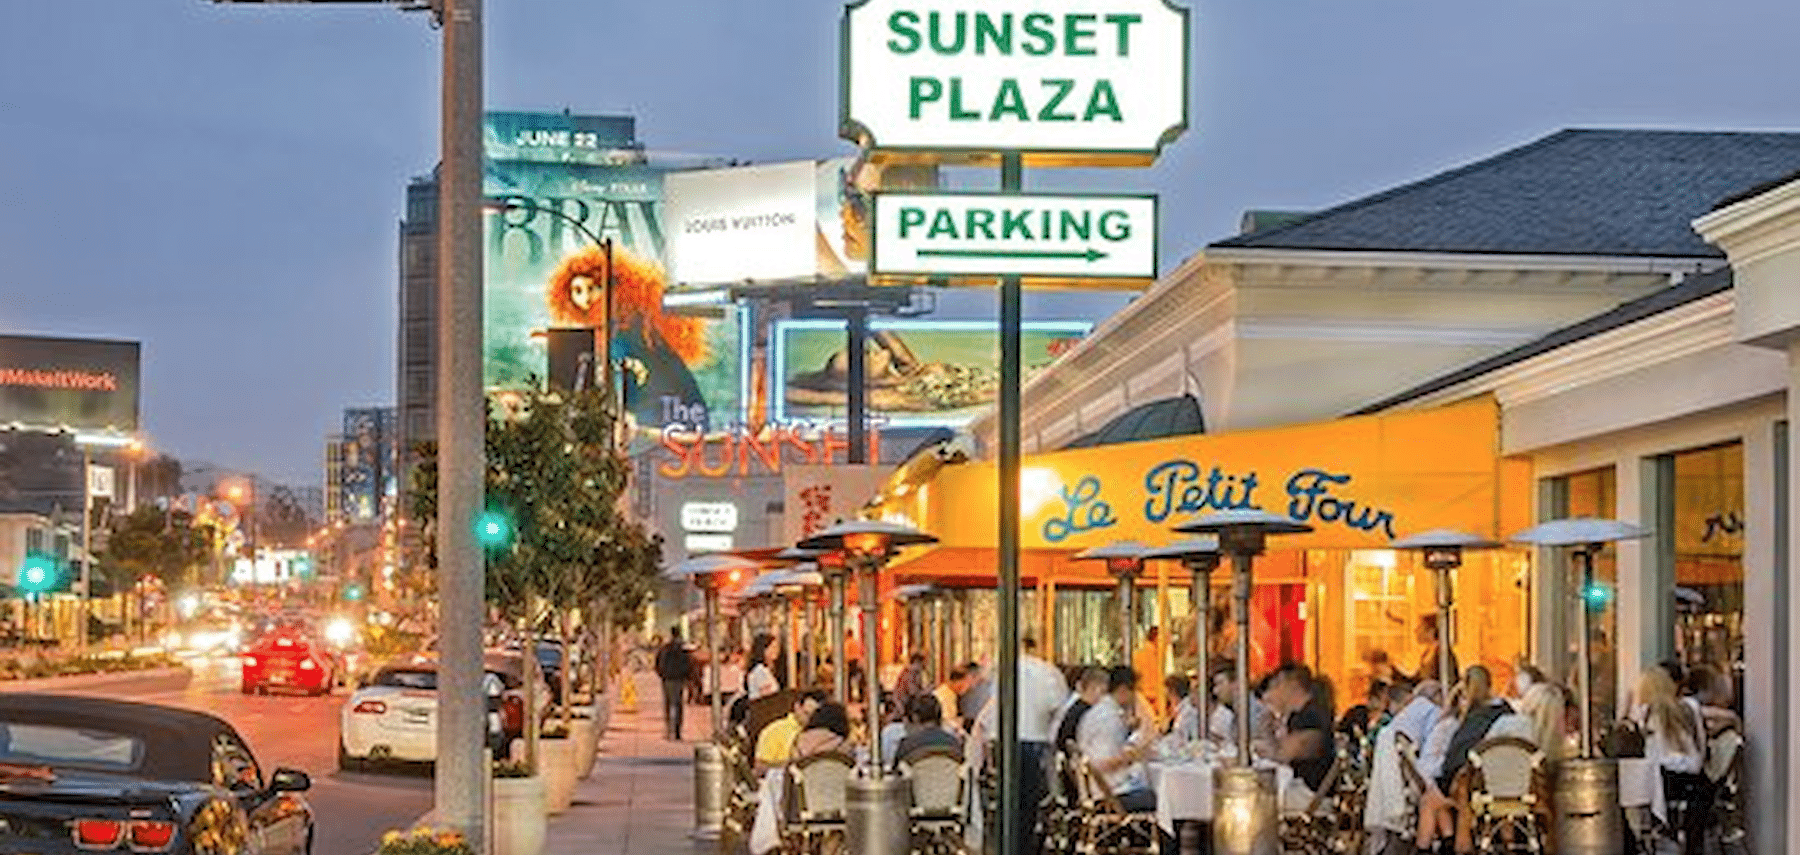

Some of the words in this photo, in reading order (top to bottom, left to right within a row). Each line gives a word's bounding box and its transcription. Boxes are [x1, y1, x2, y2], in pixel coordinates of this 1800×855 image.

[887, 11, 1142, 56] SUNSET
[909, 76, 1124, 122] PLAZA
[516, 130, 571, 147] JUNE
[574, 132, 598, 148] 22
[899, 207, 1132, 242] PARKING
[660, 395, 706, 422] The
[658, 417, 889, 479] SUNSET
[1043, 476, 1117, 541] Le
[1145, 460, 1263, 522] Petit
[1286, 470, 1395, 539] Four
